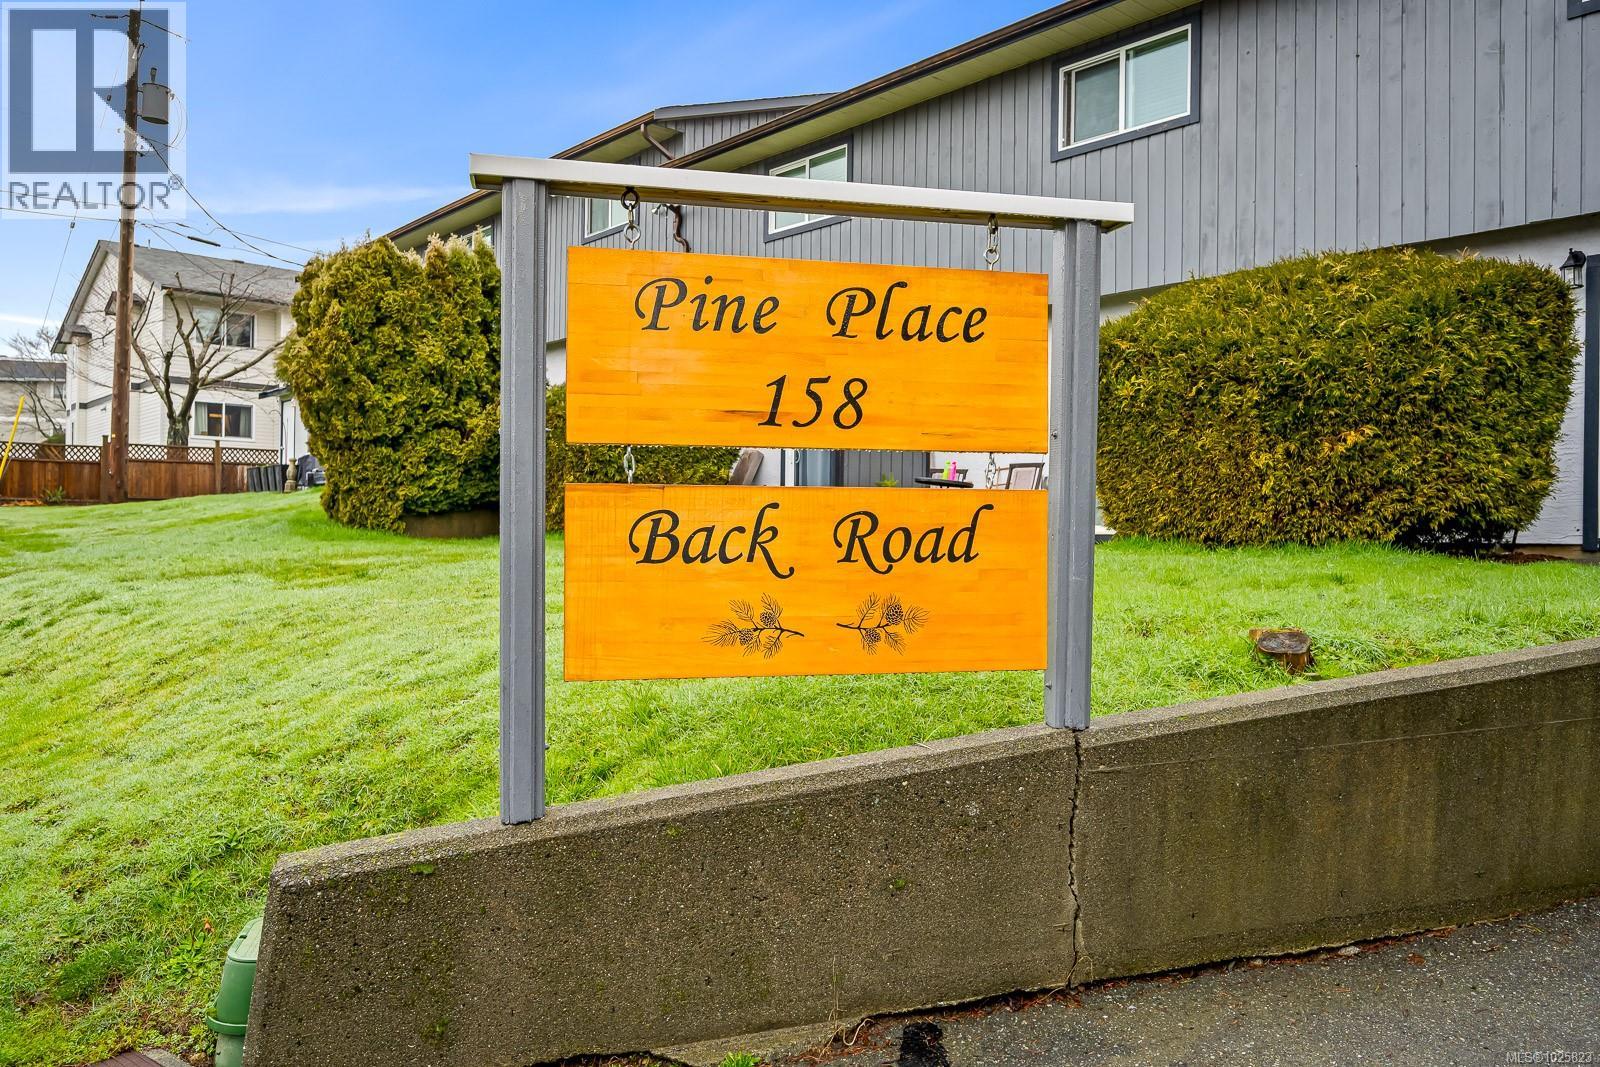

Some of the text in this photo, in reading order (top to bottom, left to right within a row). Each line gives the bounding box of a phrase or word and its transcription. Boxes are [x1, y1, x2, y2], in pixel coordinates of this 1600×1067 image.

[634, 275, 988, 343] Pine Place
[757, 374, 868, 430] 158
[628, 502, 994, 579] Back Road
